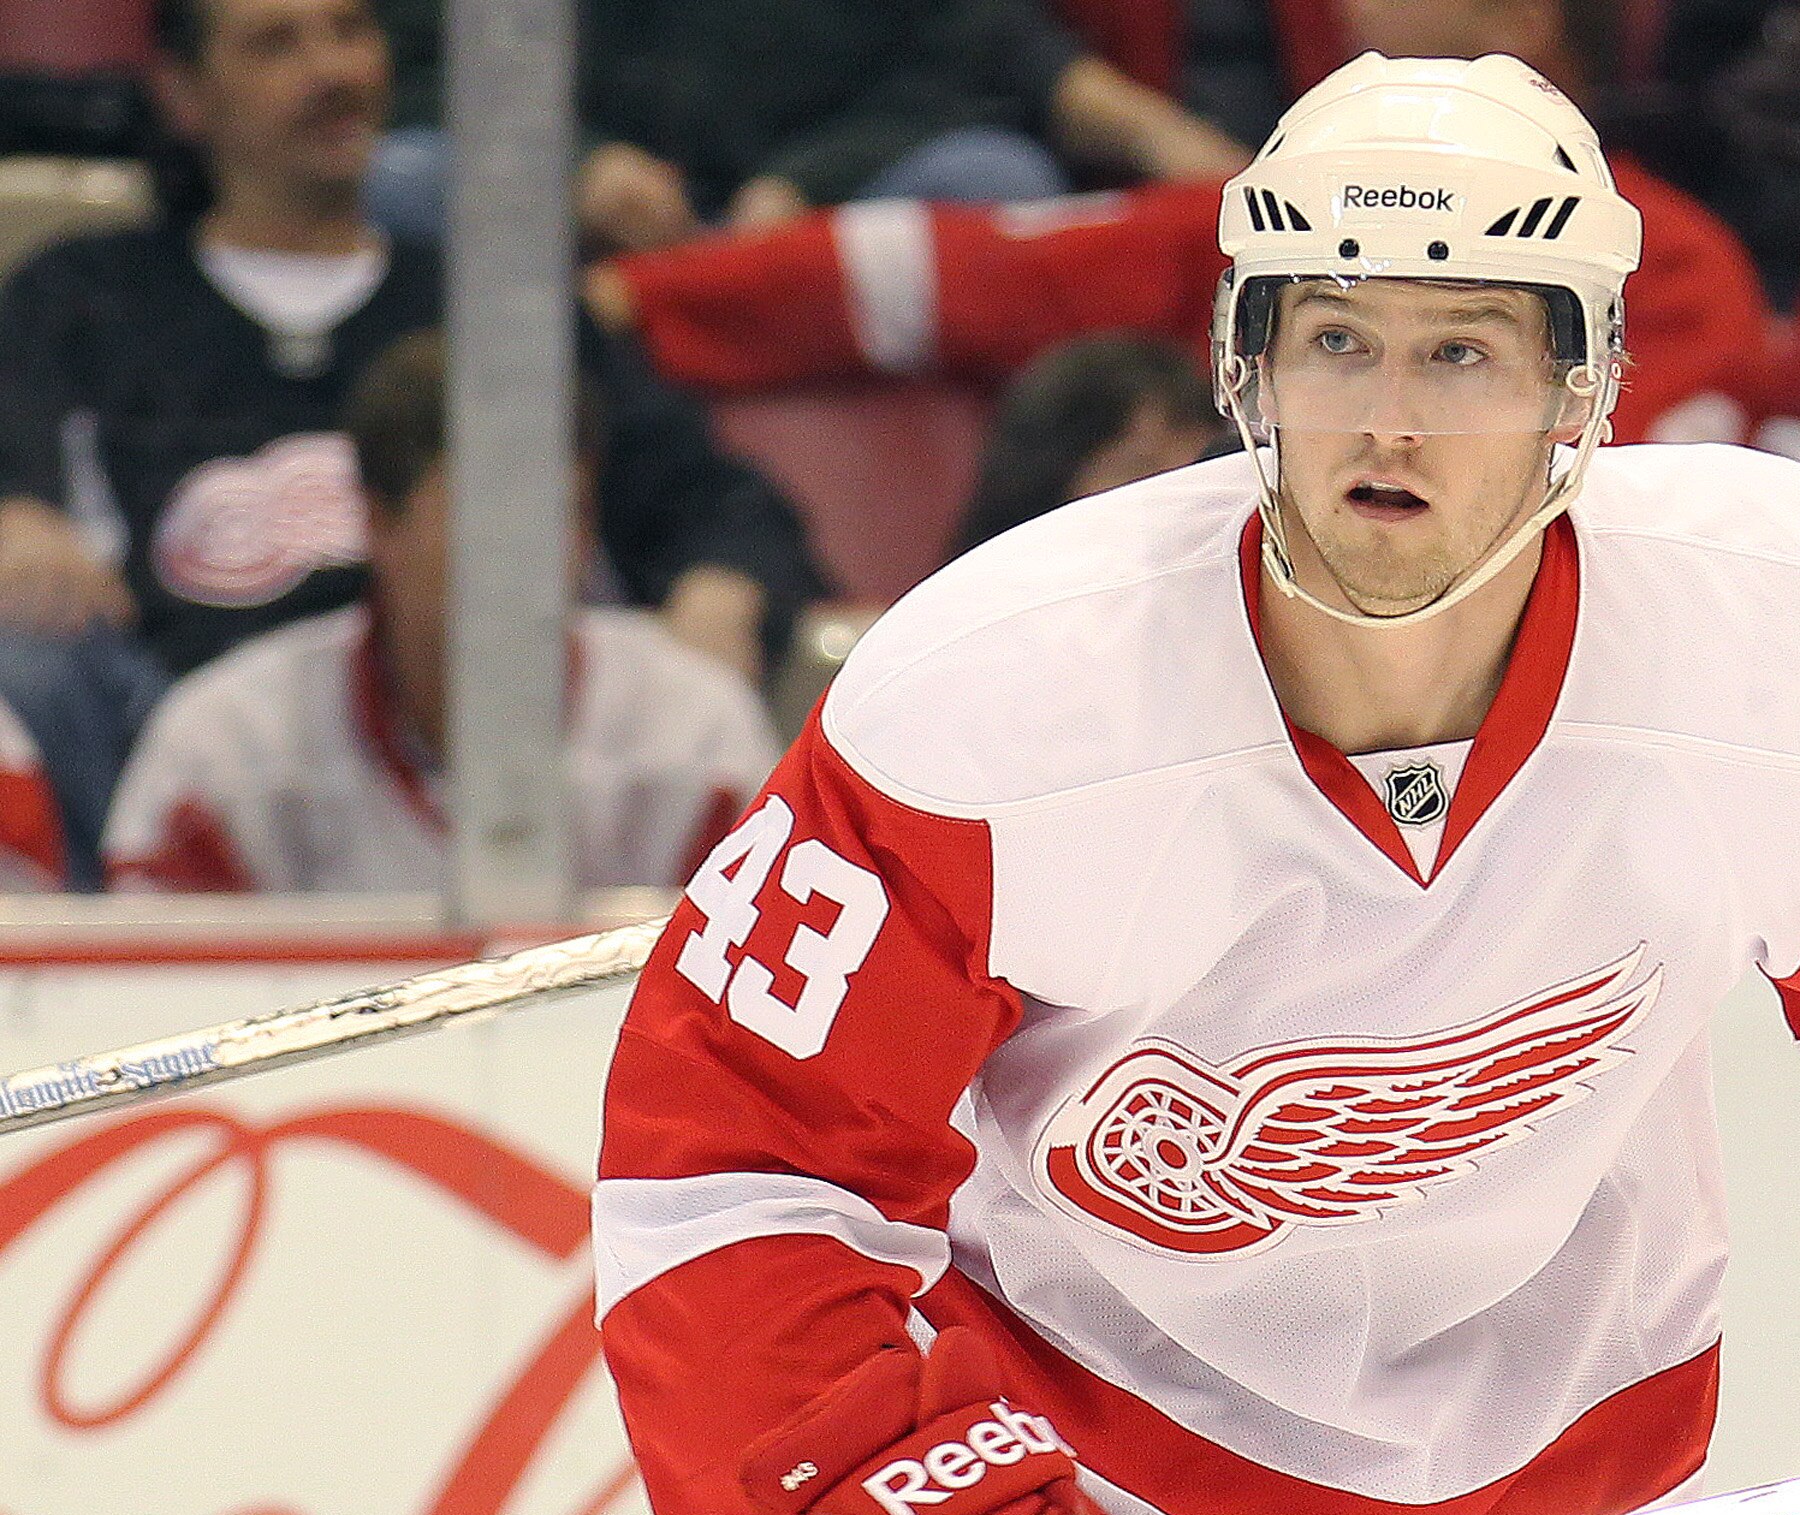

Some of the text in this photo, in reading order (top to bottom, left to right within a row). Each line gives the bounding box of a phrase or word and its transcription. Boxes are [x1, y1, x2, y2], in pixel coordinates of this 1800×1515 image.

[1343, 184, 1455, 212] Reebok
[1398, 776, 1436, 816] NHL
[674, 793, 892, 1061] 43
